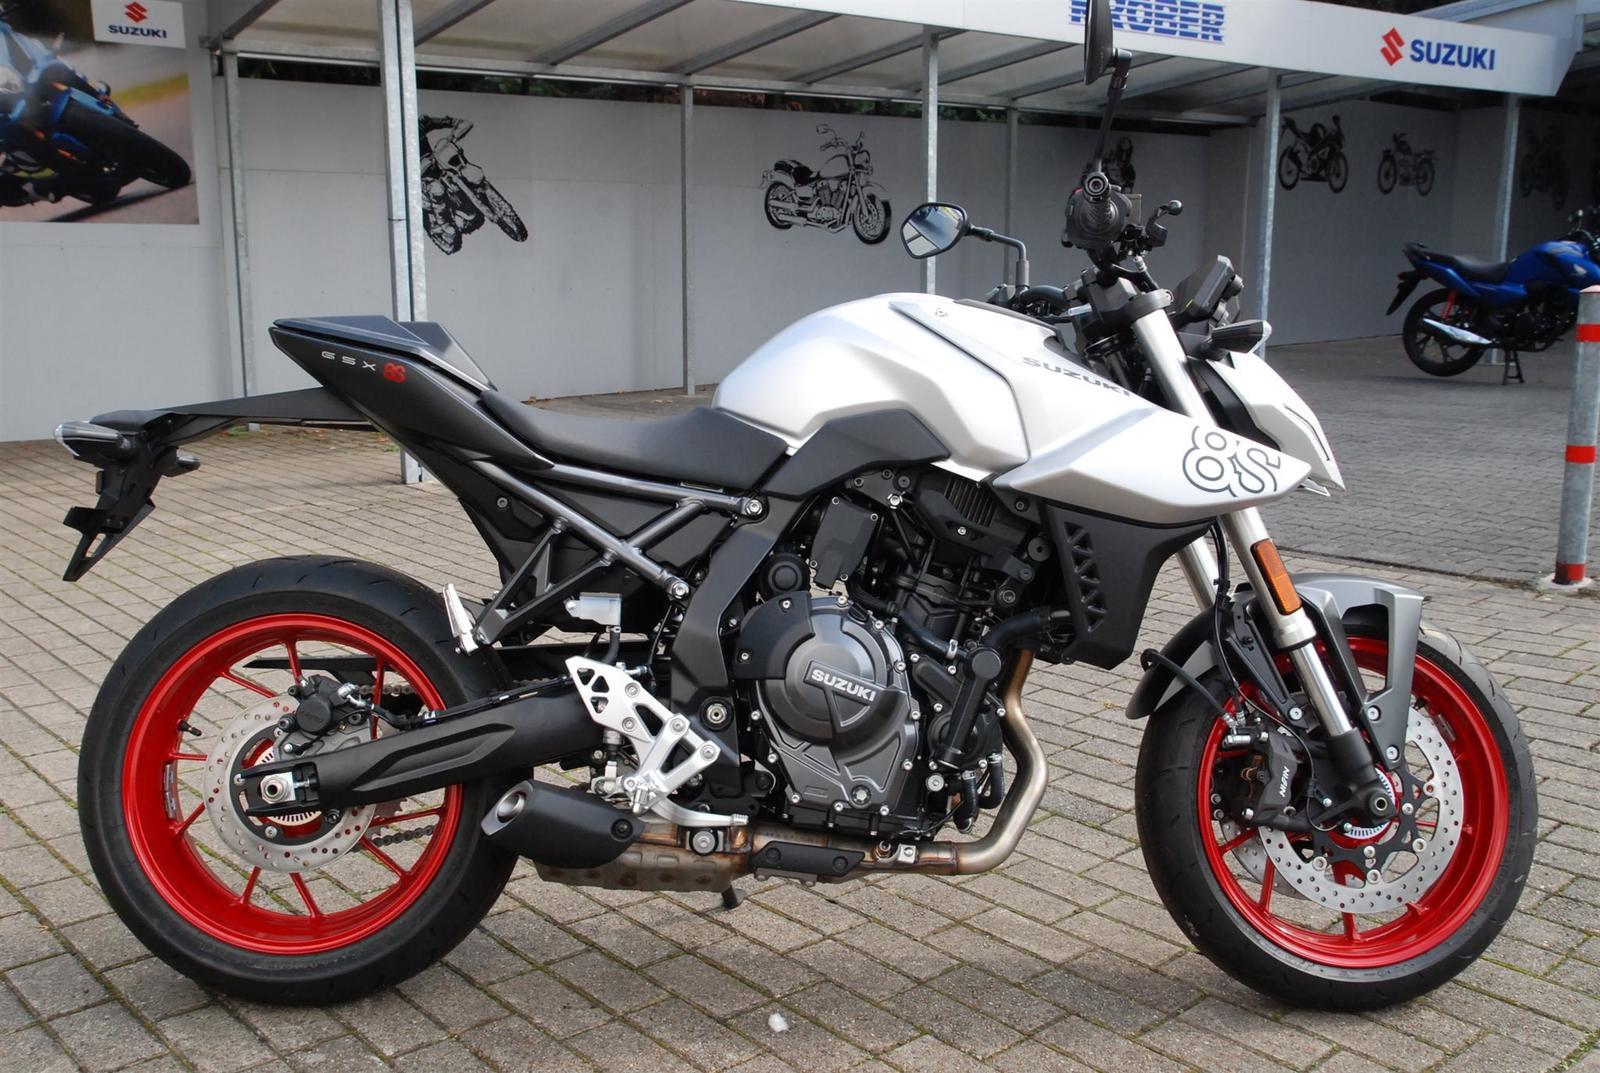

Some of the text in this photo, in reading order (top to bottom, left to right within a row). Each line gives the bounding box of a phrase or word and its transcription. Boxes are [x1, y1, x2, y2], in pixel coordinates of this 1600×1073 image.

[107, 24, 168, 39] SUZUKI
[1409, 38, 1496, 71] SUZUKI
[1021, 356, 1131, 397] SUZUKI
[810, 668, 878, 702] SUZUKI
